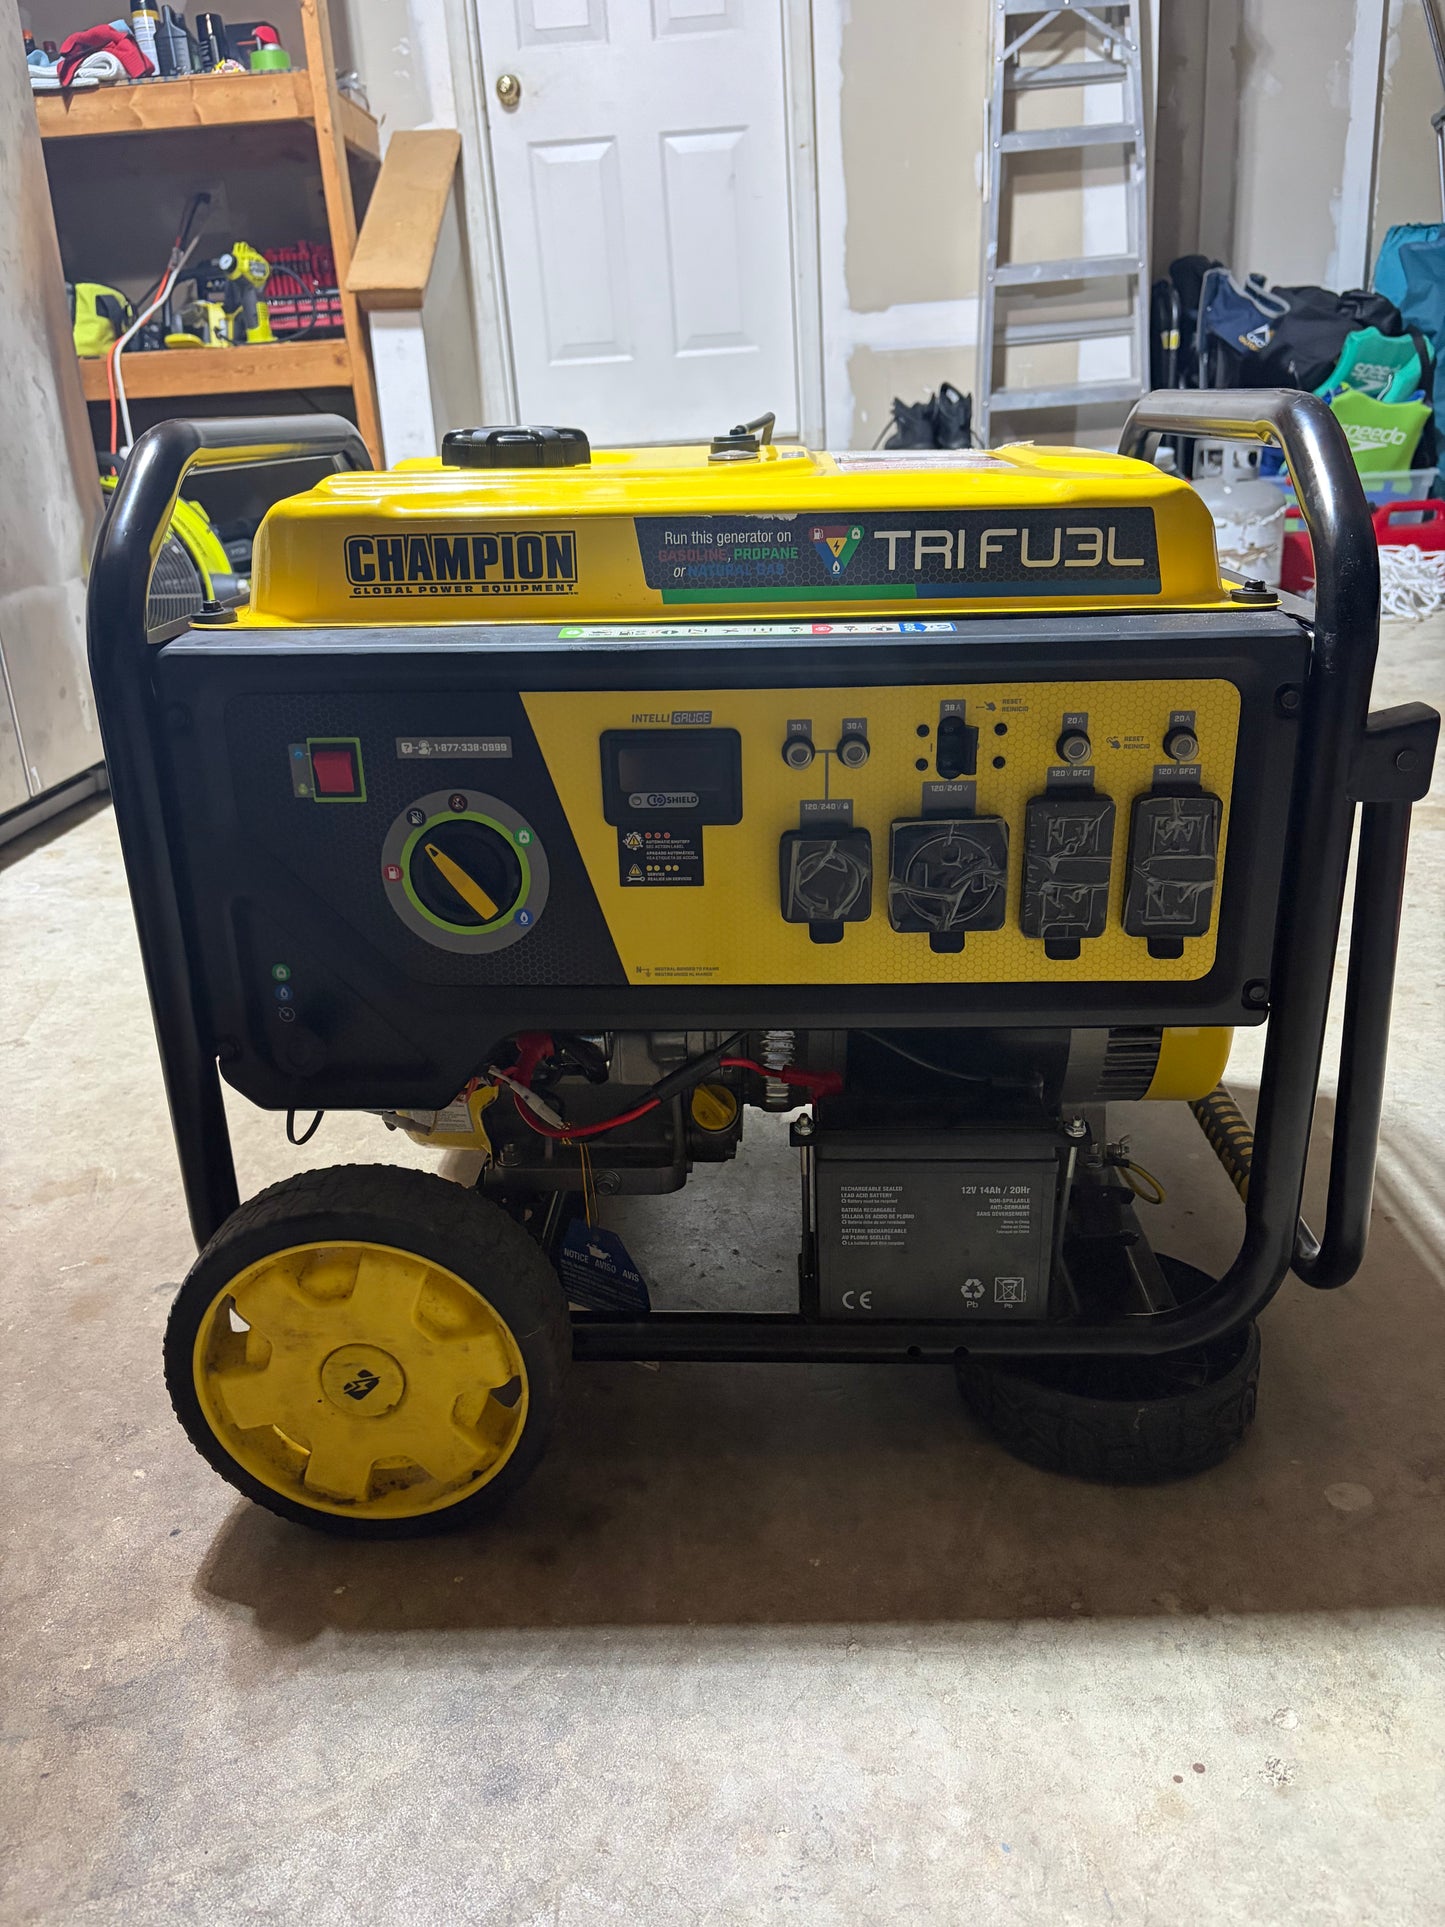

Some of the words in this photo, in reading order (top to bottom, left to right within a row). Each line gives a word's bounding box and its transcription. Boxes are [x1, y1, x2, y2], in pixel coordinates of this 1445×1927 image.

[664, 531, 688, 545] Run
[691, 530, 713, 545] this
[716, 530, 774, 547] generator
[776, 531, 792, 543] on
[658, 548, 731, 563] GASOLINE,
[733, 547, 799, 560] PROPANE
[873, 529, 965, 571] TRI
[348, 535, 575, 585] CHAMPION
[673, 566, 687, 578] or
[687, 563, 752, 577] NATURAL
[756, 563, 784, 575] GAS
[353, 587, 413, 596] GLOBAL
[418, 585, 474, 594] POWER
[481, 584, 575, 594] EQUIPMENT
[1072, 769, 1091, 777] GFCI
[1178, 767, 1197, 775] GFCI
[666, 796, 698, 804] SHIELD
[961, 1186, 977, 1194] 12V
[980, 1186, 1001, 1194] 14Ah
[1009, 1186, 1031, 1194] 20Hr
[563, 1247, 589, 1264] NOTICE
[594, 1259, 617, 1275] AVISO
[622, 1269, 640, 1283] AVIS
[966, 1300, 979, 1309] Pb
